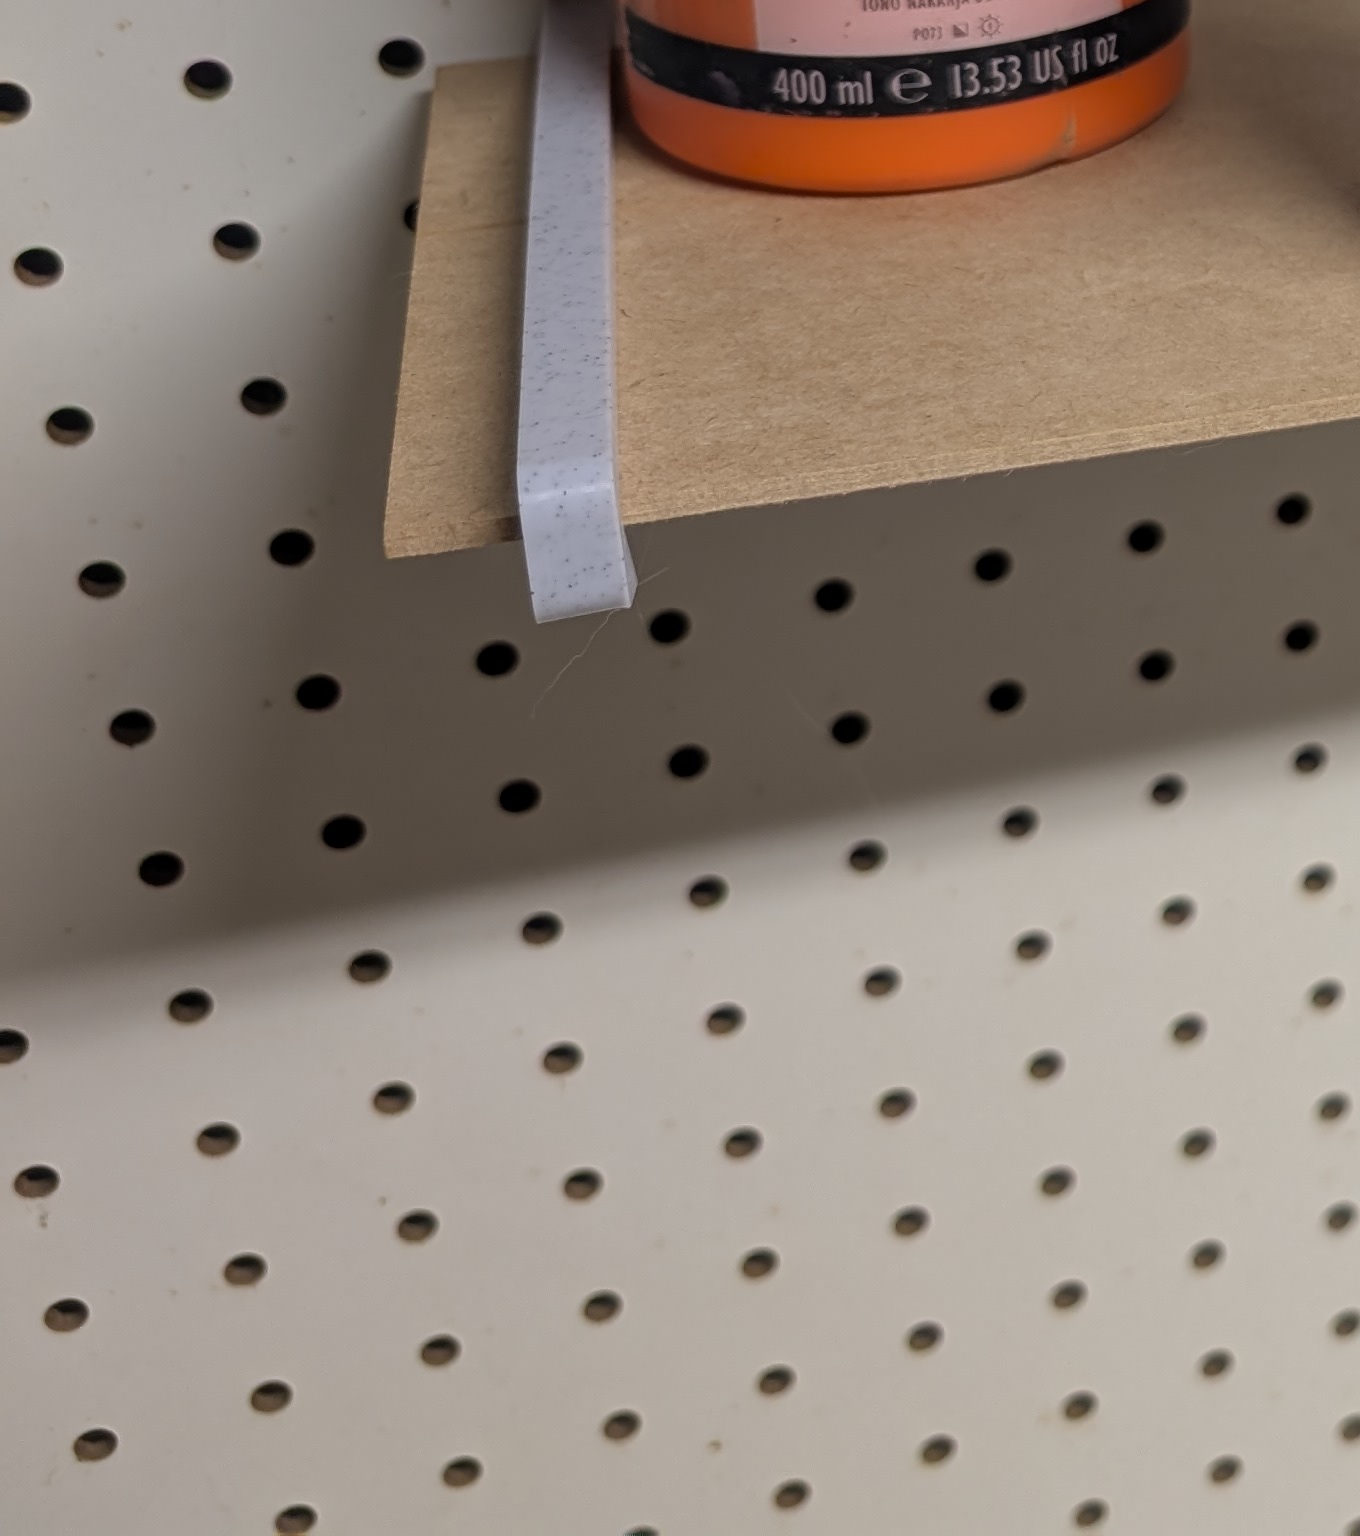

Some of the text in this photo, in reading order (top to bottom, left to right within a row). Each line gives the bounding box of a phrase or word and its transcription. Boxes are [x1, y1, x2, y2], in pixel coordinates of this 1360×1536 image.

[772, 67, 827, 105] 400
[837, 70, 873, 105] ml
[949, 55, 1023, 99] 13.53
[1033, 44, 1063, 84] US
[1072, 38, 1088, 75] fl
